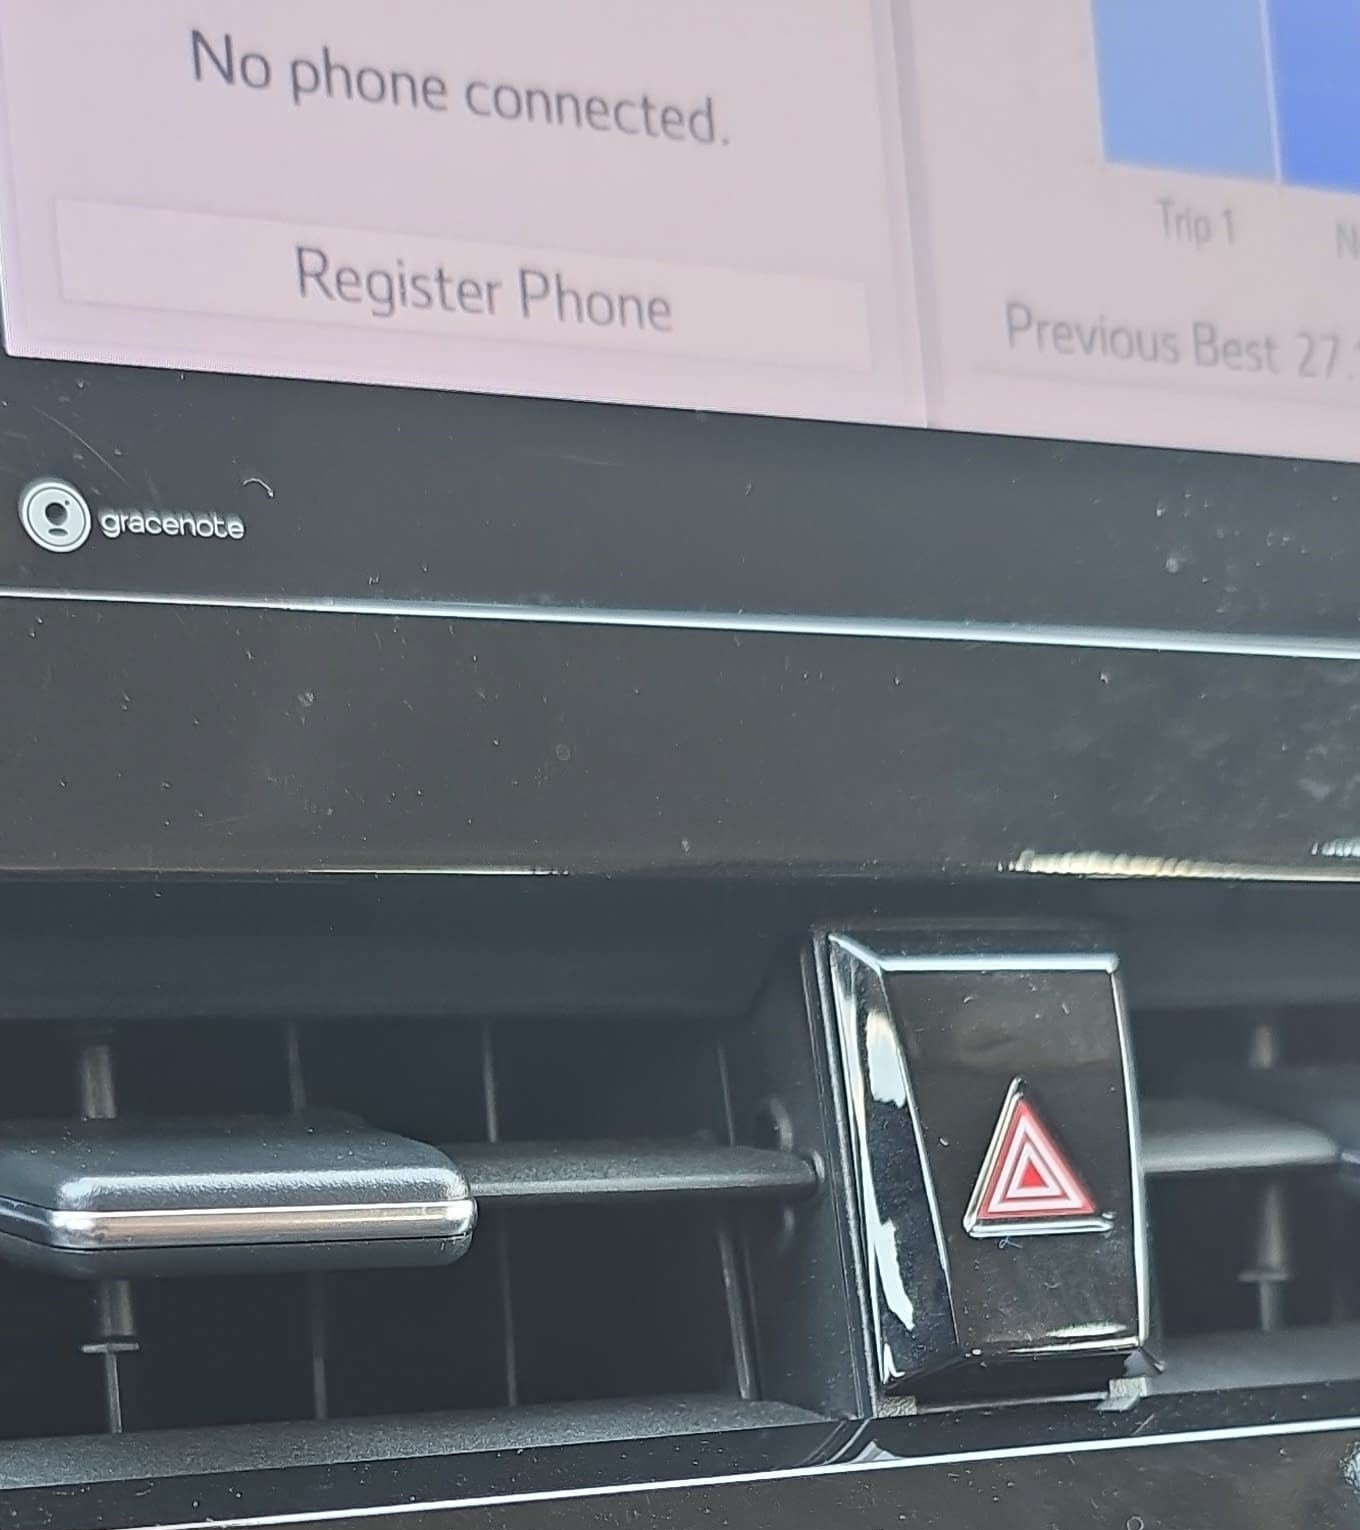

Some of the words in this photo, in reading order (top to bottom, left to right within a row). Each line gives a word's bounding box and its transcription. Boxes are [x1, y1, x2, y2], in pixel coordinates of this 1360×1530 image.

[189, 28, 271, 88] No
[290, 46, 448, 113] phone
[464, 77, 731, 147] connected.
[1156, 196, 1214, 247] Trip
[1220, 207, 1236, 244] 1
[295, 244, 503, 318] Register
[519, 268, 674, 331] Phone
[1004, 300, 1181, 366] Previous
[1192, 320, 1280, 373] Best
[100, 506, 245, 542] gracenote
